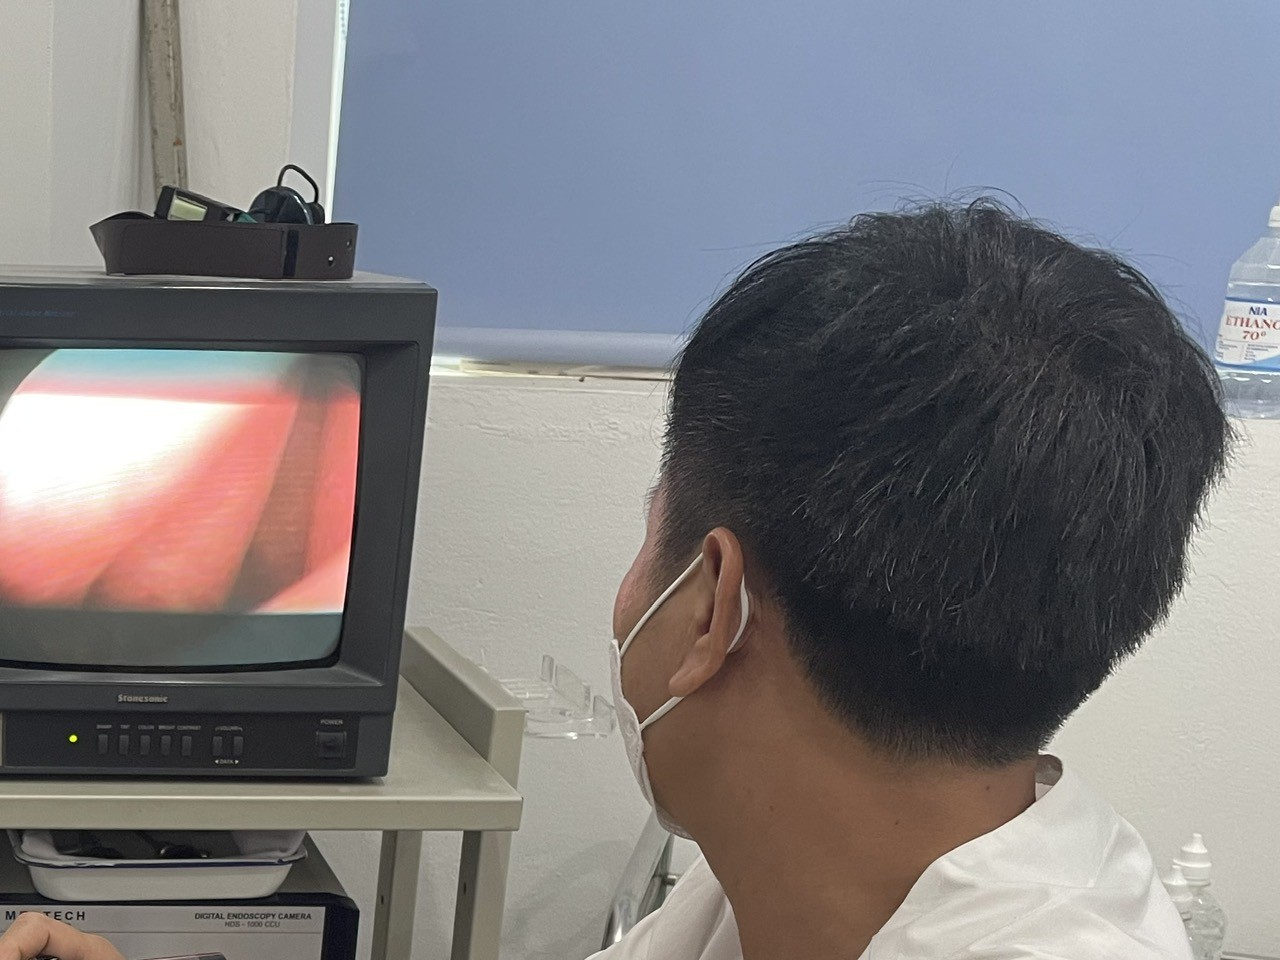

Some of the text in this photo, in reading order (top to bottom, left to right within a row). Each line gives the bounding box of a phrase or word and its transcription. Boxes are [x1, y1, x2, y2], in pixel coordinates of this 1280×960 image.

[1248, 306, 1268, 316] NIA
[5, 911, 86, 921] MTECH
[194, 912, 226, 920] DIGITAL
[227, 912, 276, 920] ENDOSCOPY
